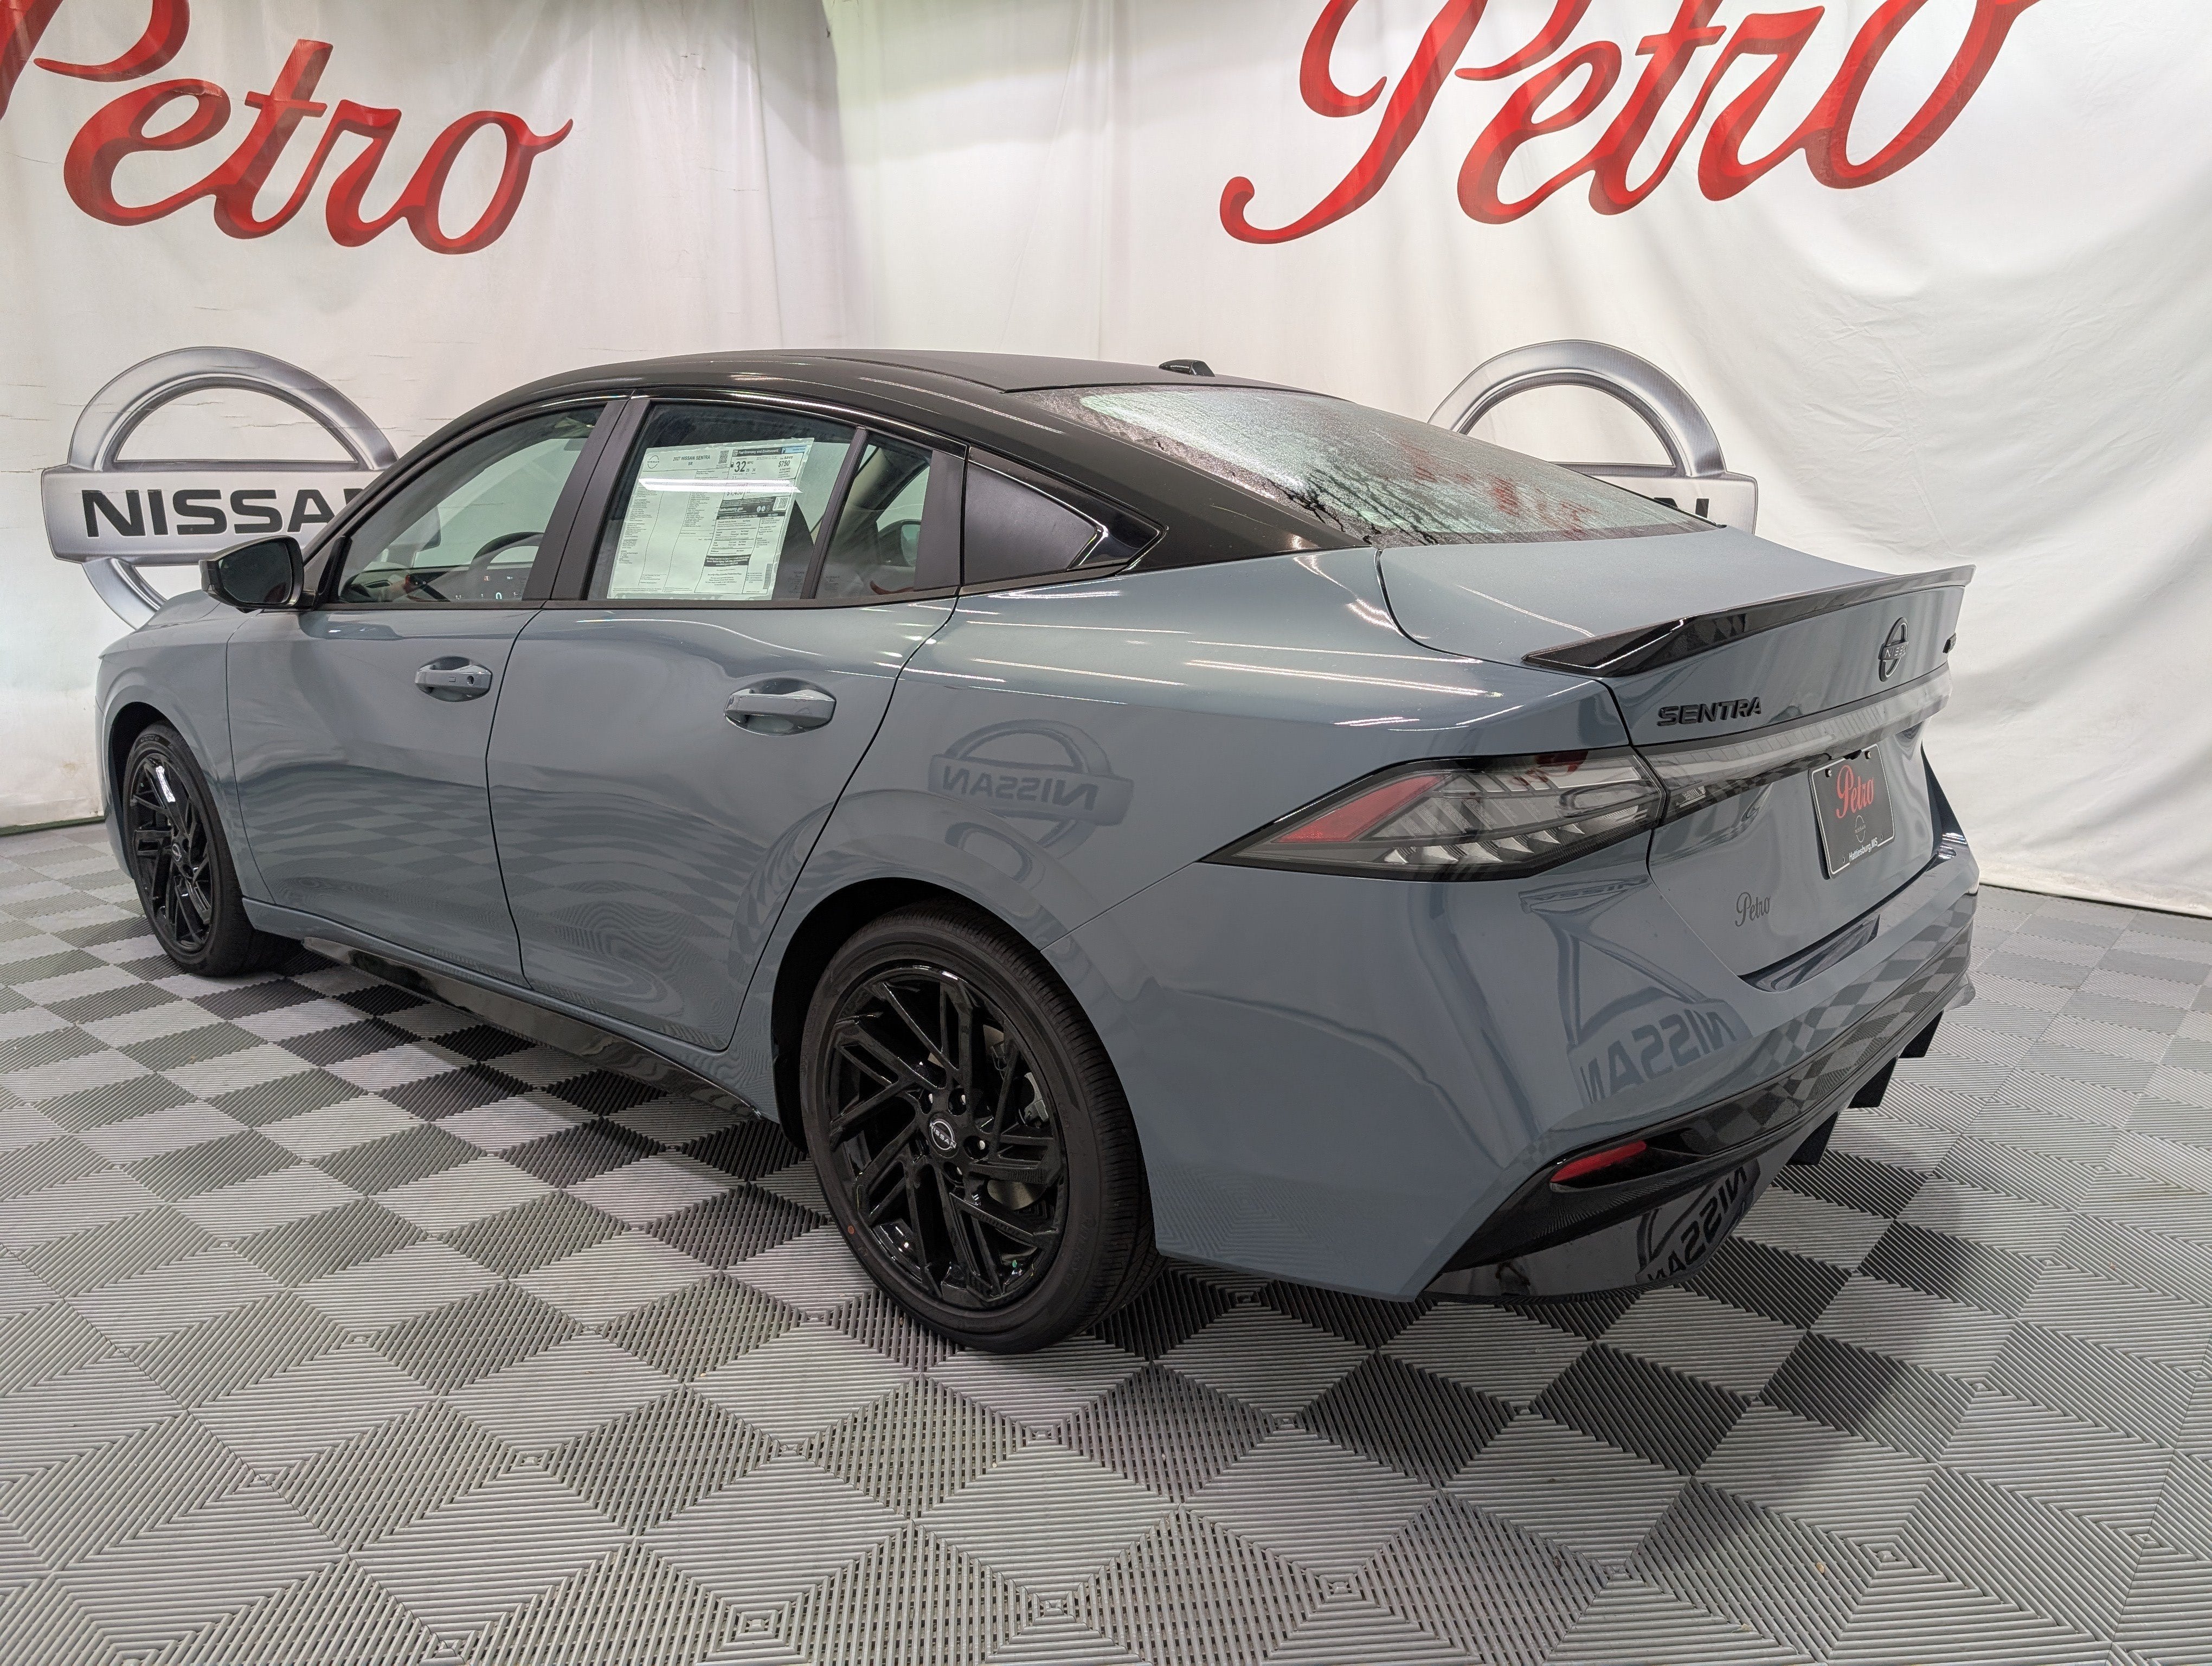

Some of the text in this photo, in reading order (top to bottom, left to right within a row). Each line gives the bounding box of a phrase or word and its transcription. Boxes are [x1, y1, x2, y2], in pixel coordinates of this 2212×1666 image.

[734, 460, 747, 472] 32
[81, 489, 366, 537] NISSA
[1657, 696, 1761, 727] SENTRA
[1836, 765, 1874, 819] Petro
[1735, 892, 1771, 927] Petro
[929, 1122, 956, 1149] NISSAN
